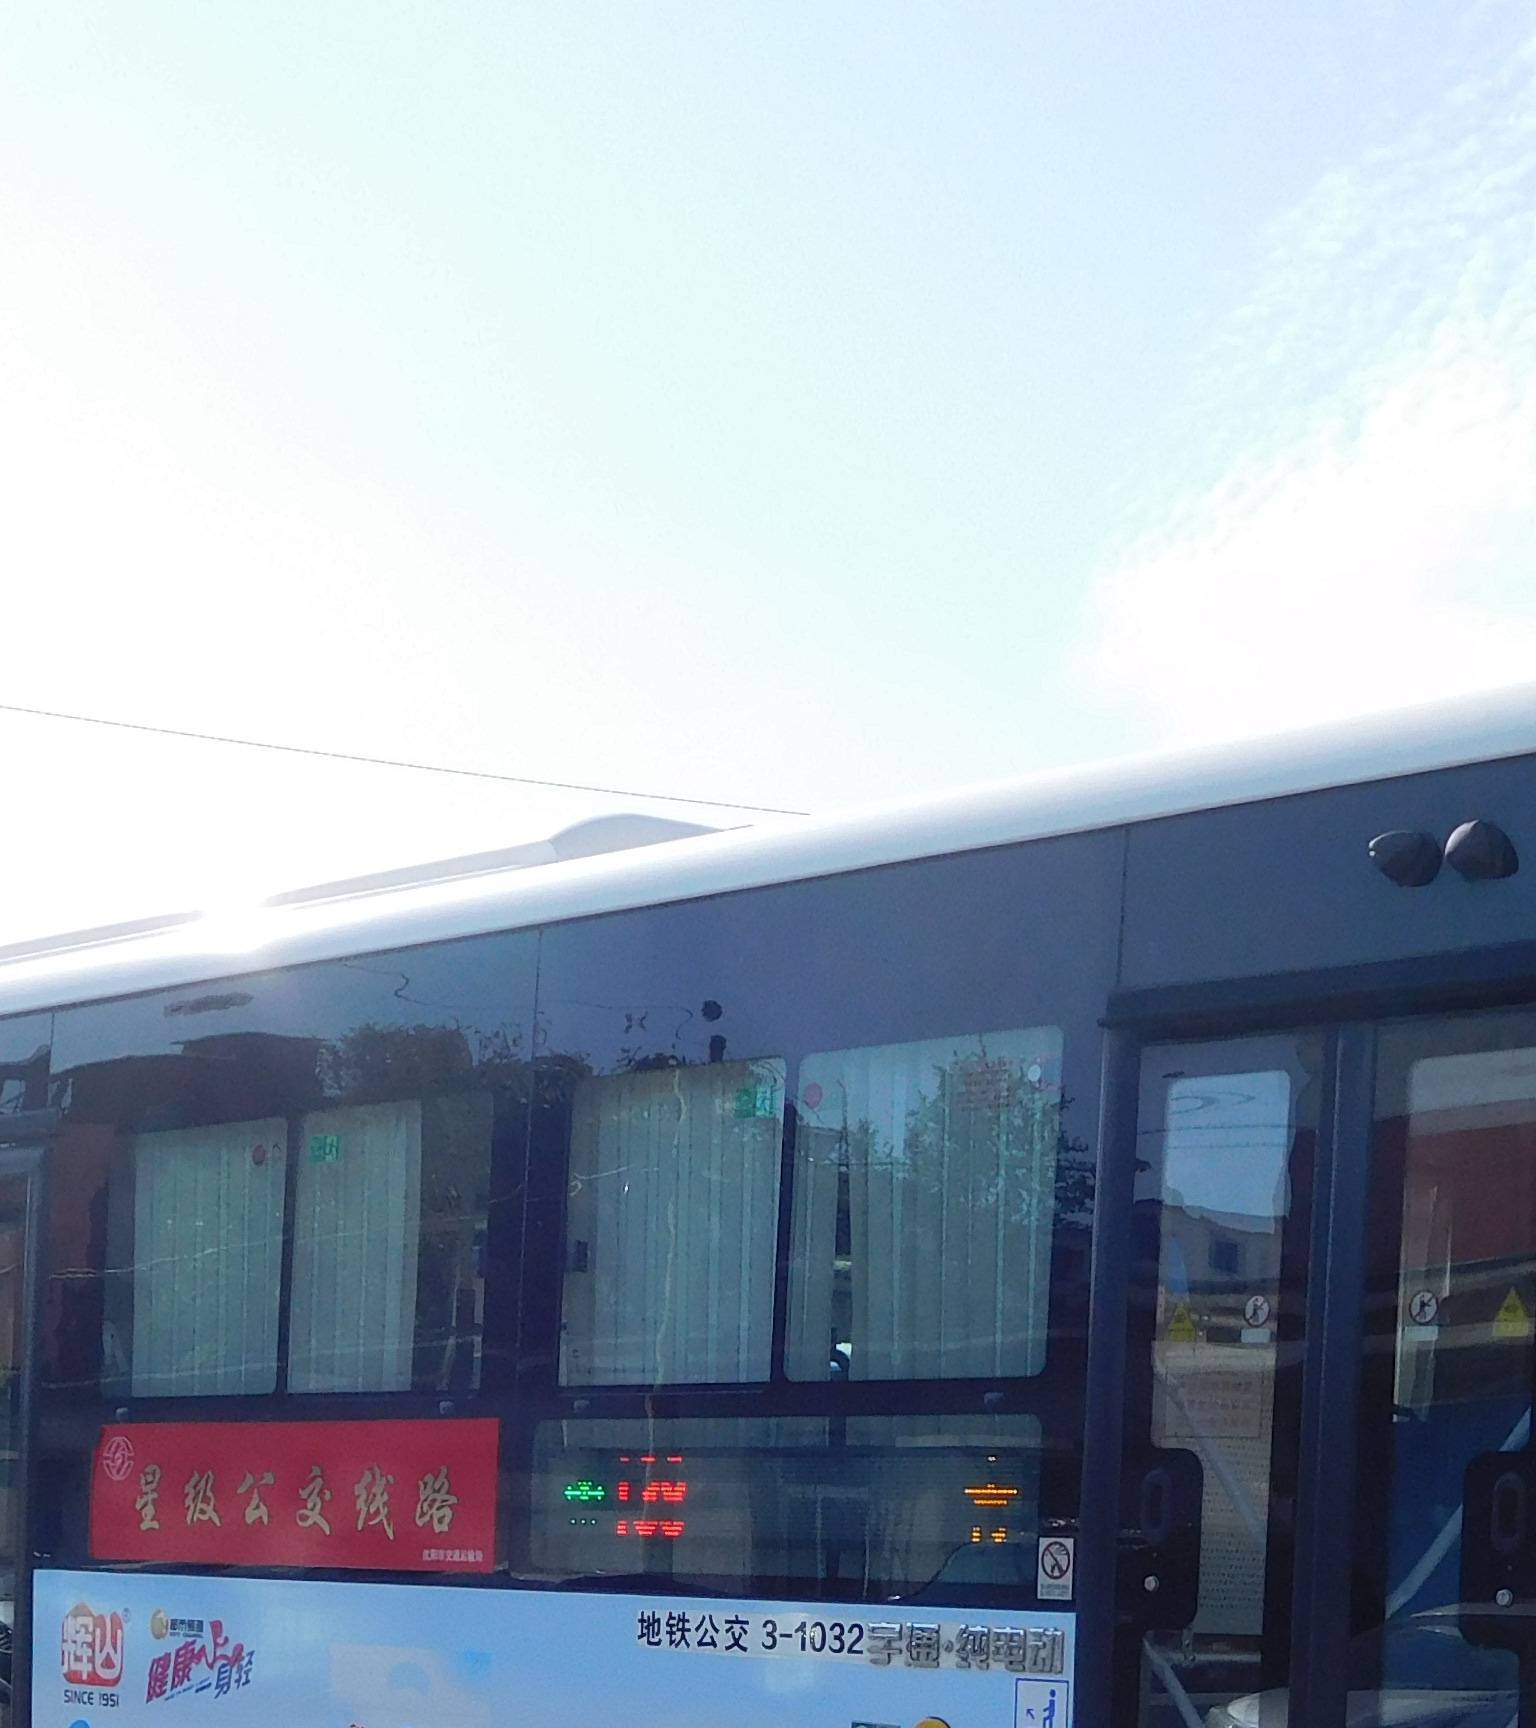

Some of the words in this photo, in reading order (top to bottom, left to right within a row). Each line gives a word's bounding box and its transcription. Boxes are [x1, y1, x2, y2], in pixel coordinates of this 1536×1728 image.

[136, 1463, 457, 1540] 星级公交线路
[638, 1610, 749, 1653] 地铁公交
[762, 1619, 864, 1655] 3-1032
[64, 1689, 95, 1705] SINCE
[98, 1692, 120, 1707] 1951
